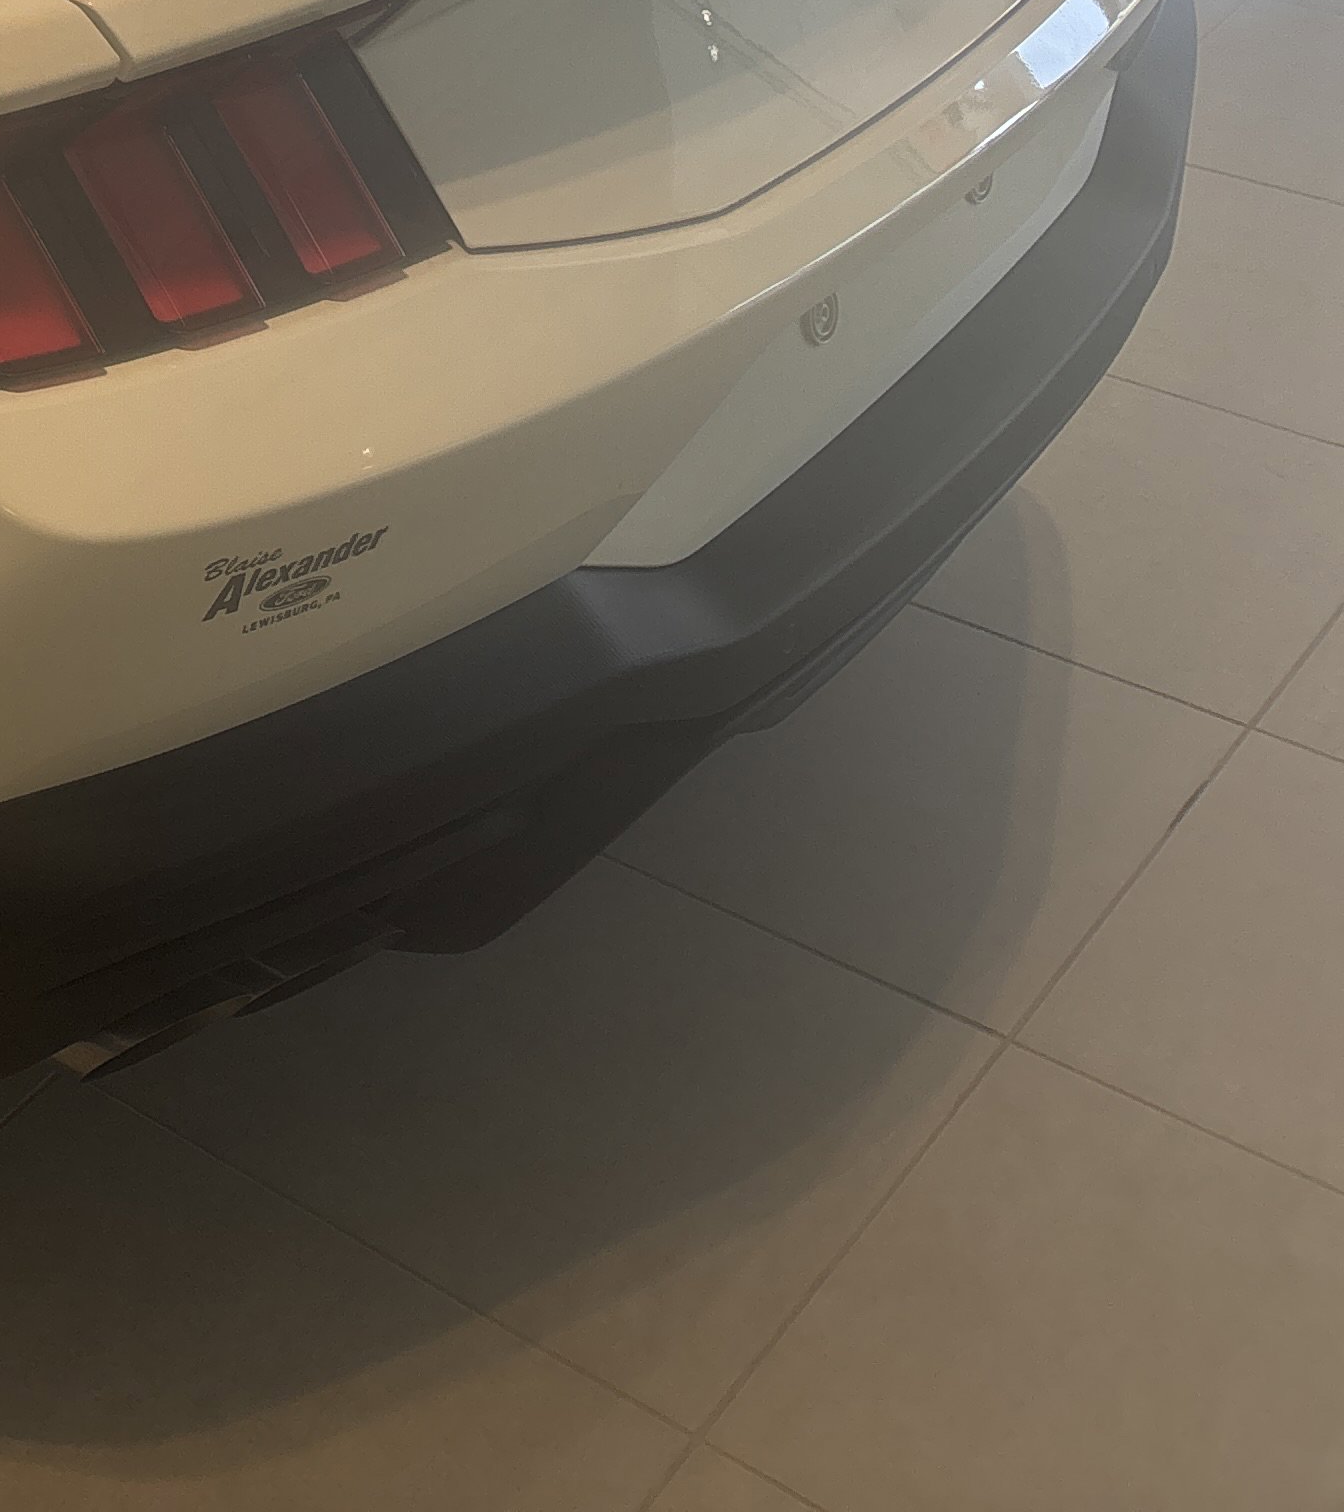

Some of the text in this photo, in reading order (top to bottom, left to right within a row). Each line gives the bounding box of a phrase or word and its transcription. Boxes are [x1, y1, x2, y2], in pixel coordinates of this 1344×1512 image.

[201, 525, 389, 622] Alexander
[203, 547, 284, 582] Blaise
[241, 591, 341, 634] LEWISBURG, PA
